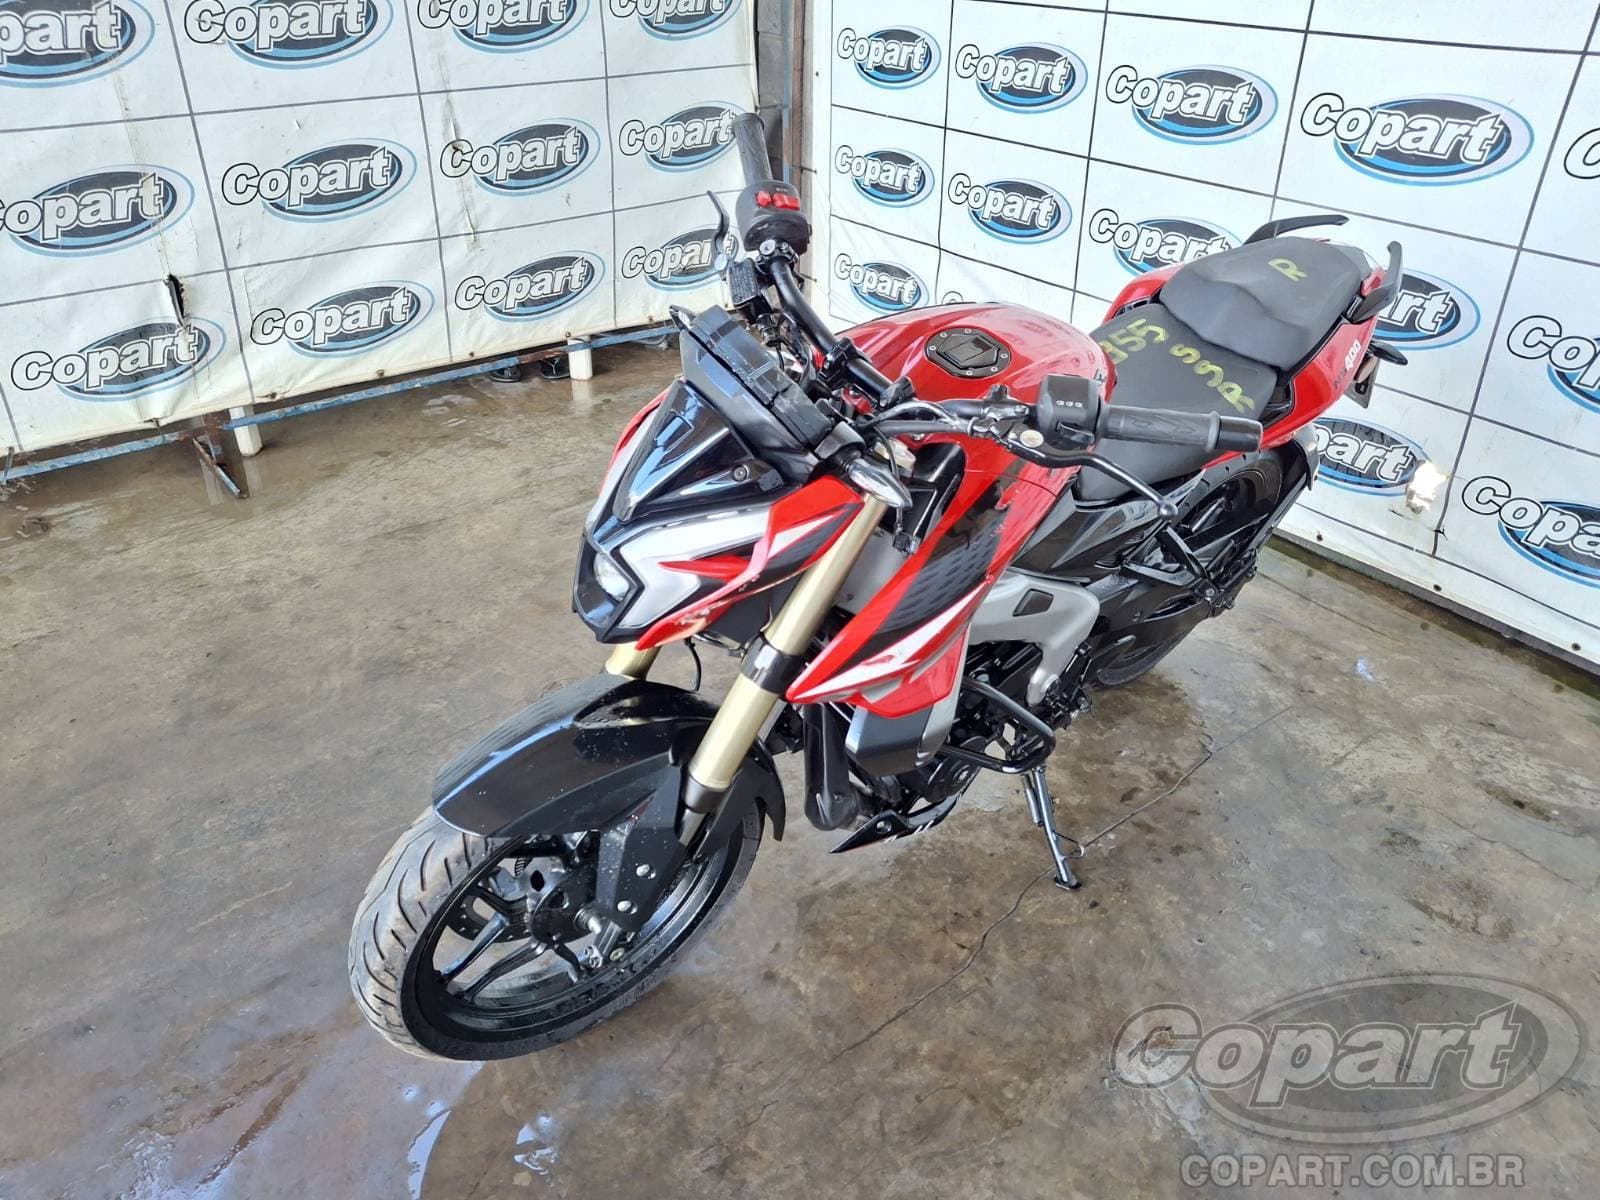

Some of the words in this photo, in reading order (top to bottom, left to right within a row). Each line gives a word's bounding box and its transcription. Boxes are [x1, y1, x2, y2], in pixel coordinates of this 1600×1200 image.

[184, 0, 367, 51] Copart
[417, 0, 568, 36] Copart
[837, 28, 928, 72] Copart
[955, 44, 1074, 96] Copart
[1105, 65, 1258, 124] Copart
[440, 126, 582, 181] Copart
[619, 109, 738, 158] Copart
[1300, 92, 1505, 165] Copart
[222, 147, 393, 207] Copart
[834, 145, 924, 195] Copart
[0, 173, 164, 243] opart
[948, 173, 1060, 230] Copart
[455, 256, 590, 310] Copart
[834, 253, 917, 306] Copart
[1267, 257, 1308, 282] R
[251, 286, 412, 346] Copart
[11, 326, 201, 391] Copart
